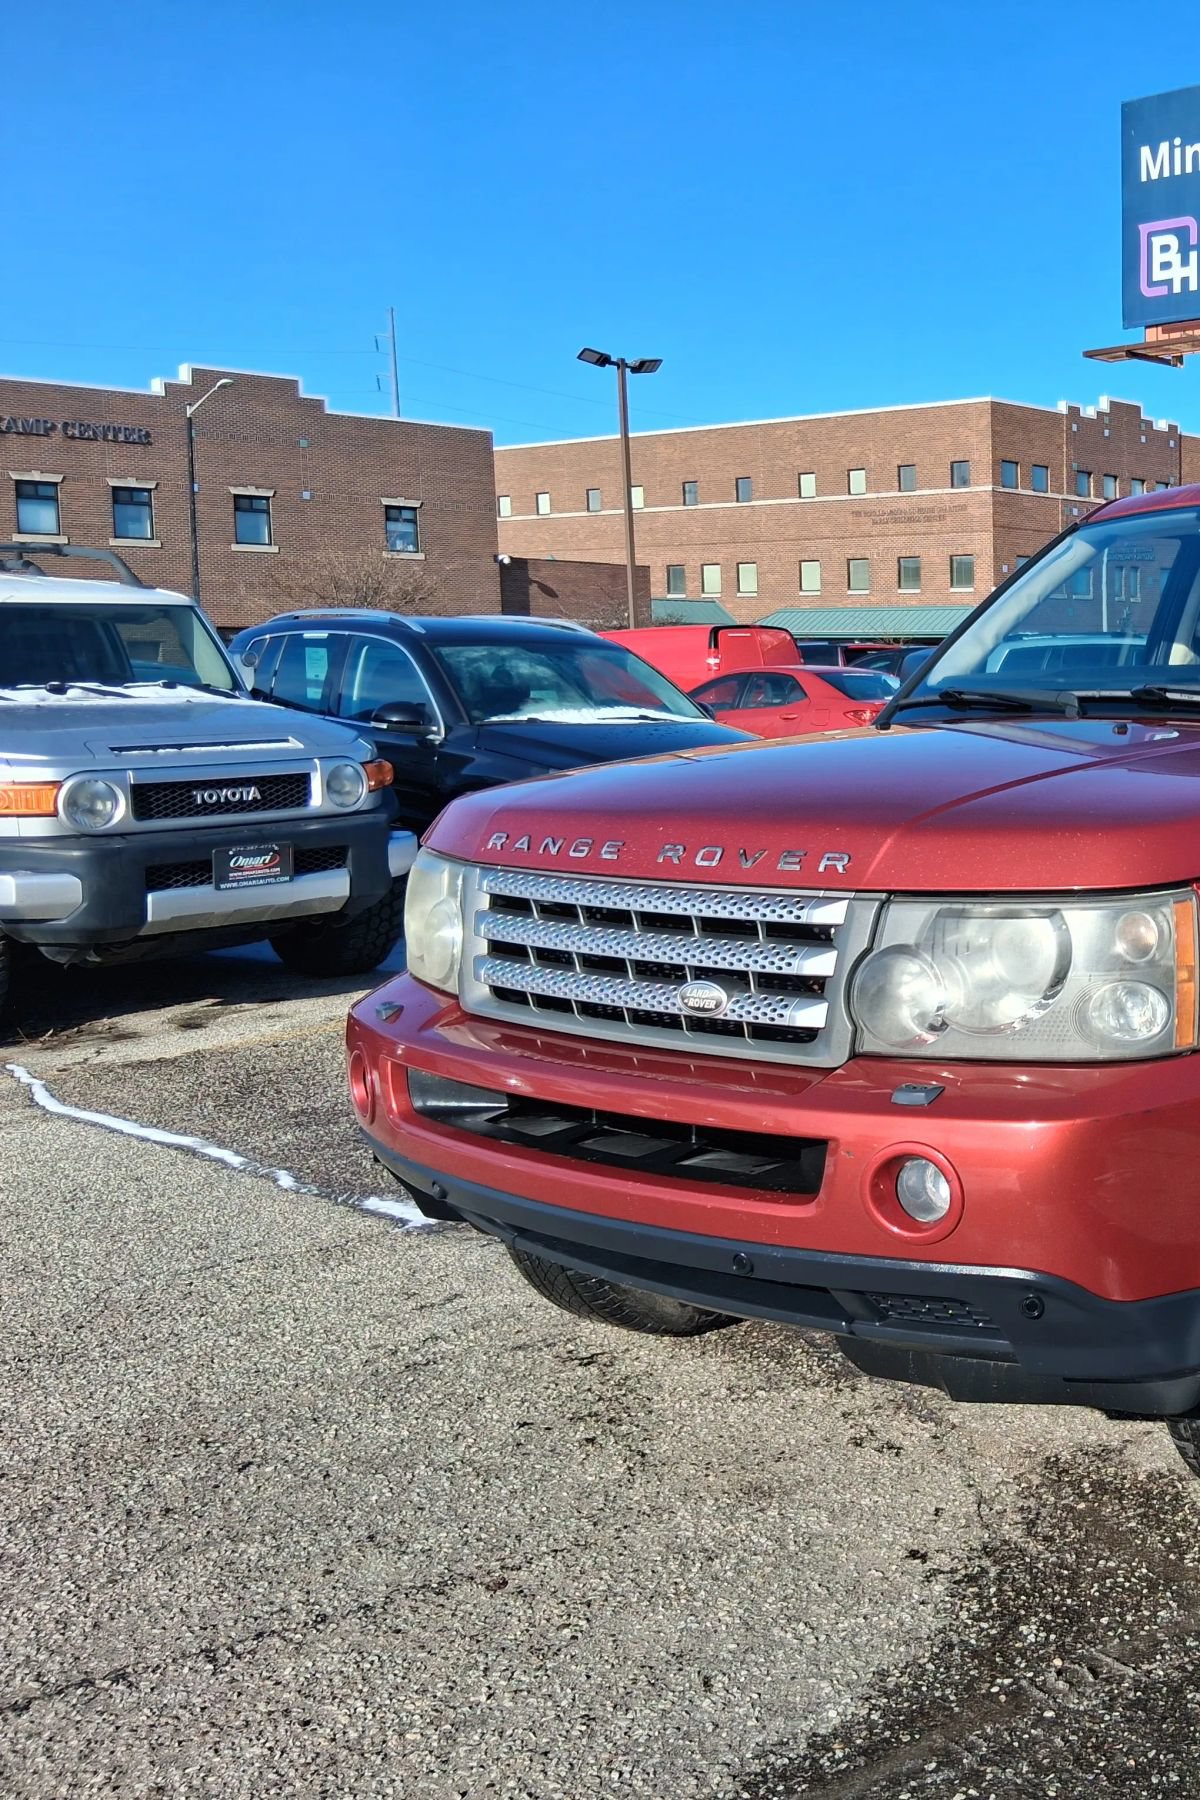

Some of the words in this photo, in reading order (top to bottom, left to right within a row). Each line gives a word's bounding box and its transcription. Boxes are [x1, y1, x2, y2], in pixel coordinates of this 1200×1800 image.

[0, 415, 53, 436] AMP
[60, 420, 152, 445] CENTER
[192, 786, 262, 804] TOYOTA
[229, 852, 274, 868] Omari
[487, 832, 625, 860] RANGE
[656, 843, 852, 875] ROVER
[220, 876, 290, 889] WWW.OMARIAUTO.COM
[686, 988, 710, 998] LAND
[688, 997, 717, 1009] ROVER
